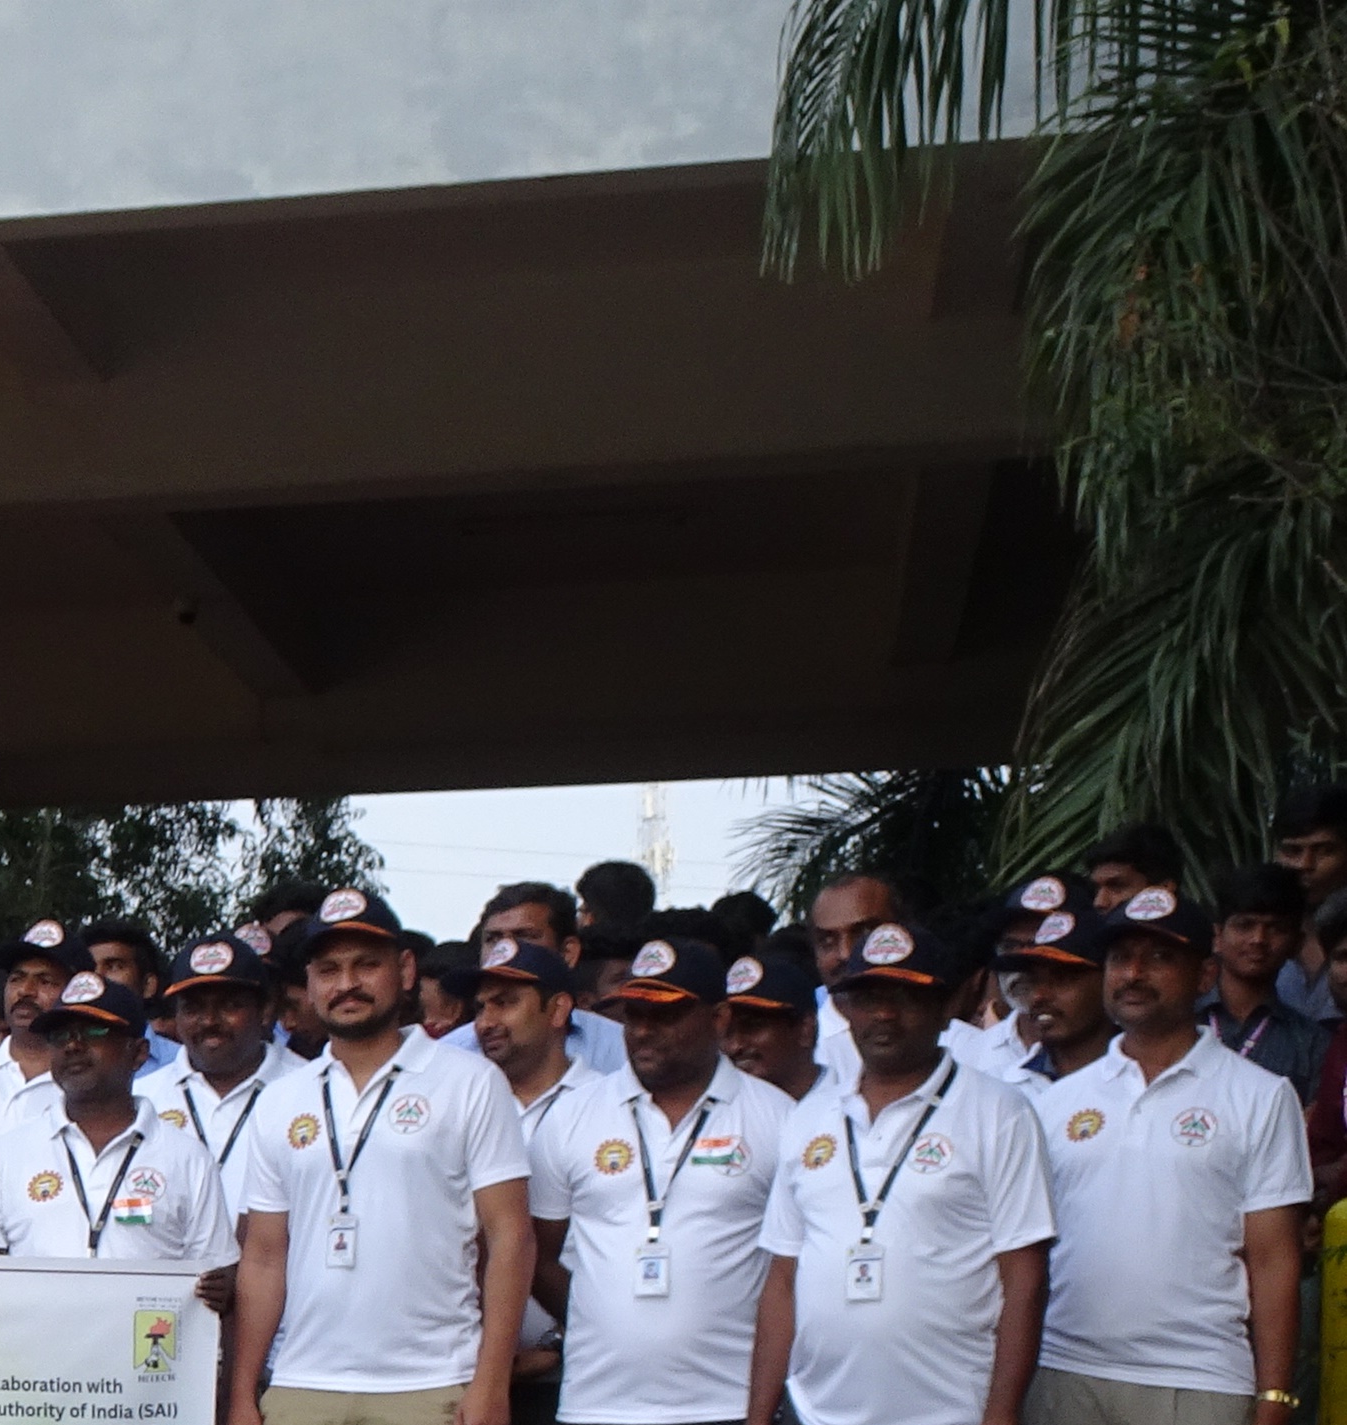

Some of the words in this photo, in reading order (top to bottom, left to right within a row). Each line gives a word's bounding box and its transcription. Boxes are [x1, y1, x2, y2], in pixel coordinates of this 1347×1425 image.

[87, 1377, 123, 1394] with
[69, 1403, 87, 1419] of
[91, 1404, 133, 1419] India
[138, 1403, 178, 1420] (SAI)
